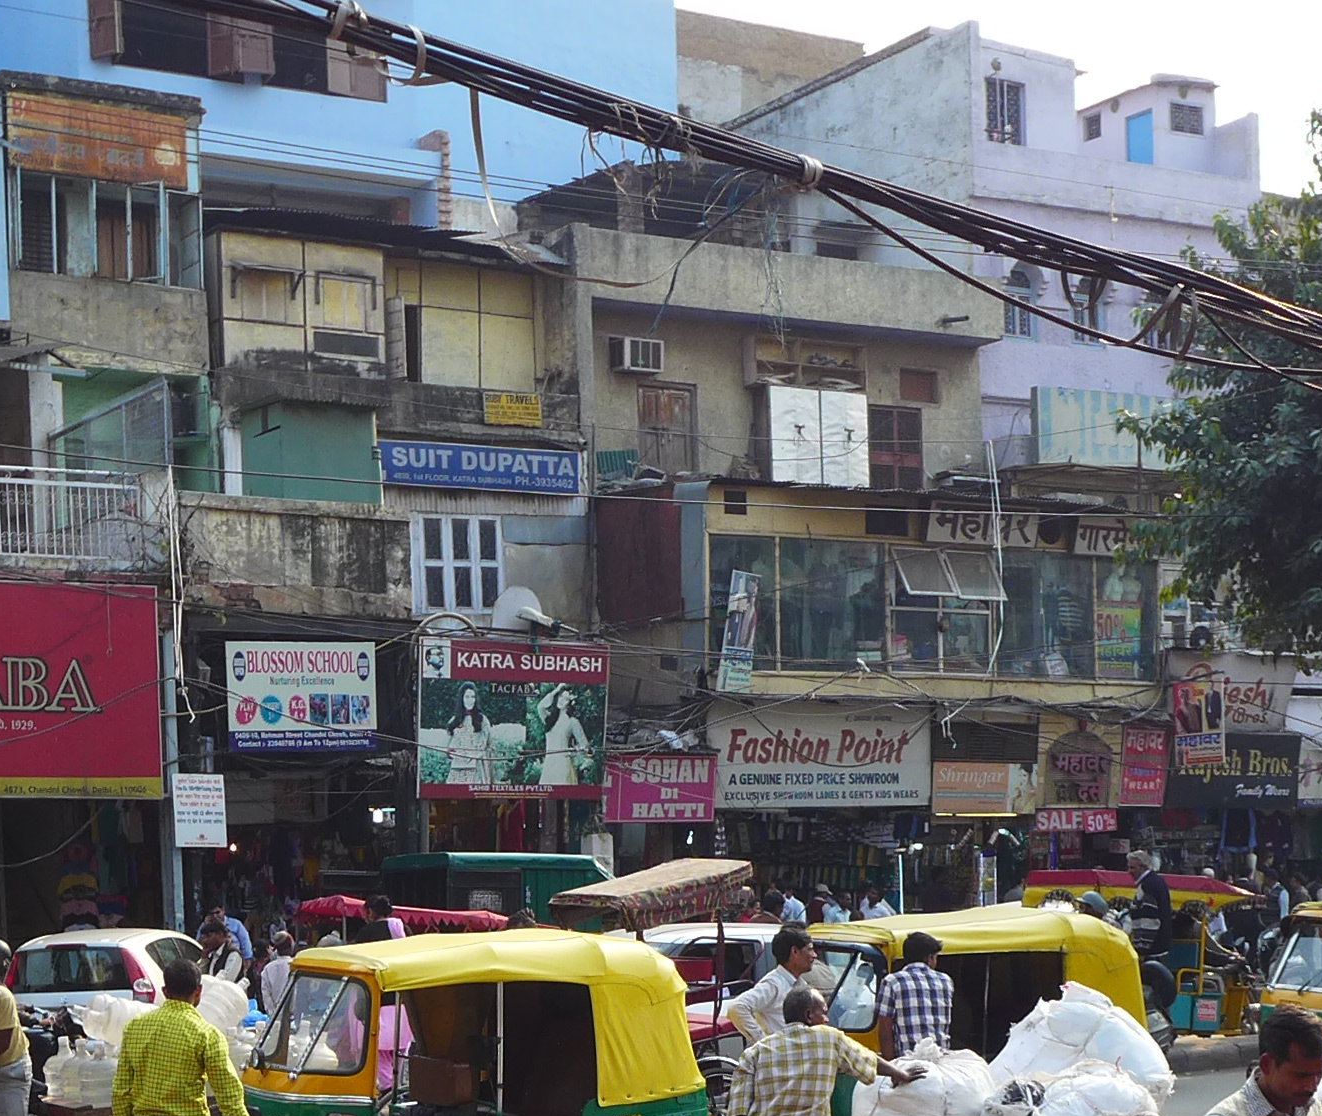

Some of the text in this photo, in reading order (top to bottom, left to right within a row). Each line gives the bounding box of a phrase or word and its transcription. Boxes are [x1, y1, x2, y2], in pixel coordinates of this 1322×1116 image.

[391, 446, 575, 477] SUIT DUPATTA
[246, 650, 356, 674] BLOSSOM SCHOOL
[456, 652, 603, 673] KATRA SUBHASH
[269, 676, 335, 687] Nurturing Excellence
[726, 727, 910, 765] Fashion Point
[631, 759, 709, 784] SOHAN
[1246, 749, 1293, 777] Bros.
[728, 772, 900, 786] A GENUINE FIXED PRICE SHOWROOM
[937, 766, 1005, 786] Shringar
[660, 787, 679, 800] DI
[724, 789, 771, 801] EXCLUSIVE
[773, 789, 813, 801] SHOWROOM
[815, 789, 839, 800] LADIES
[848, 789, 873, 800] GENTS
[875, 789, 891, 800] KIDS
[892, 788, 920, 800] WEARS
[631, 802, 706, 818] HATTI
[1037, 810, 1116, 831] SALE 50%
